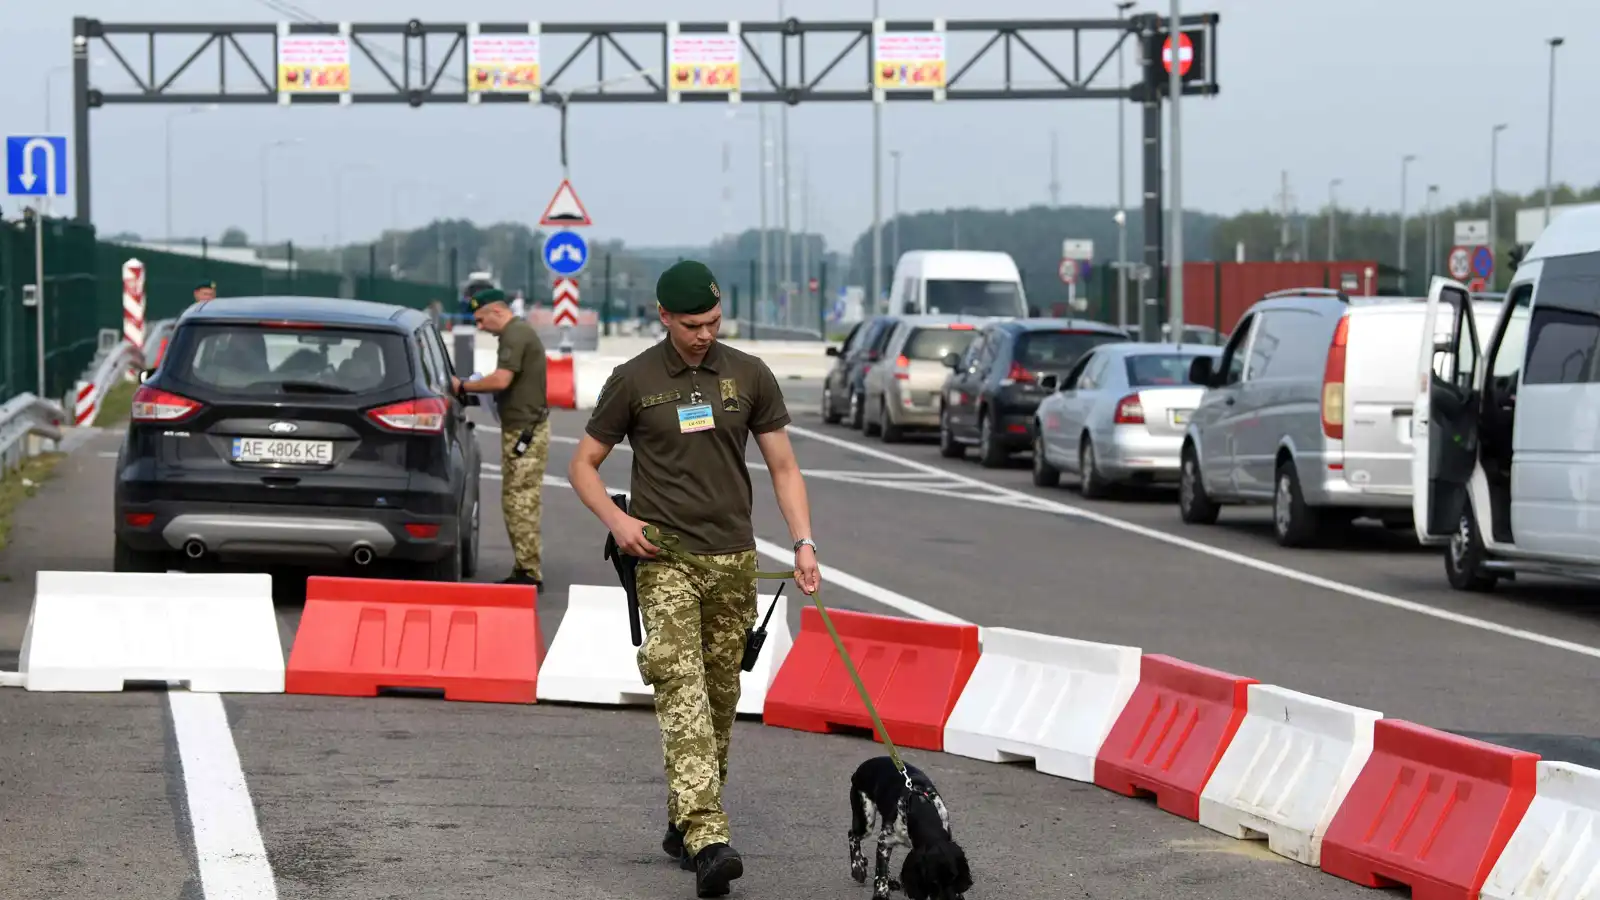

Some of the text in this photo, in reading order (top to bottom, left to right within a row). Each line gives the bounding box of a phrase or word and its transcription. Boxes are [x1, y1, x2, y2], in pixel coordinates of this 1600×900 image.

[242, 441, 327, 458] AE 4806 KE
